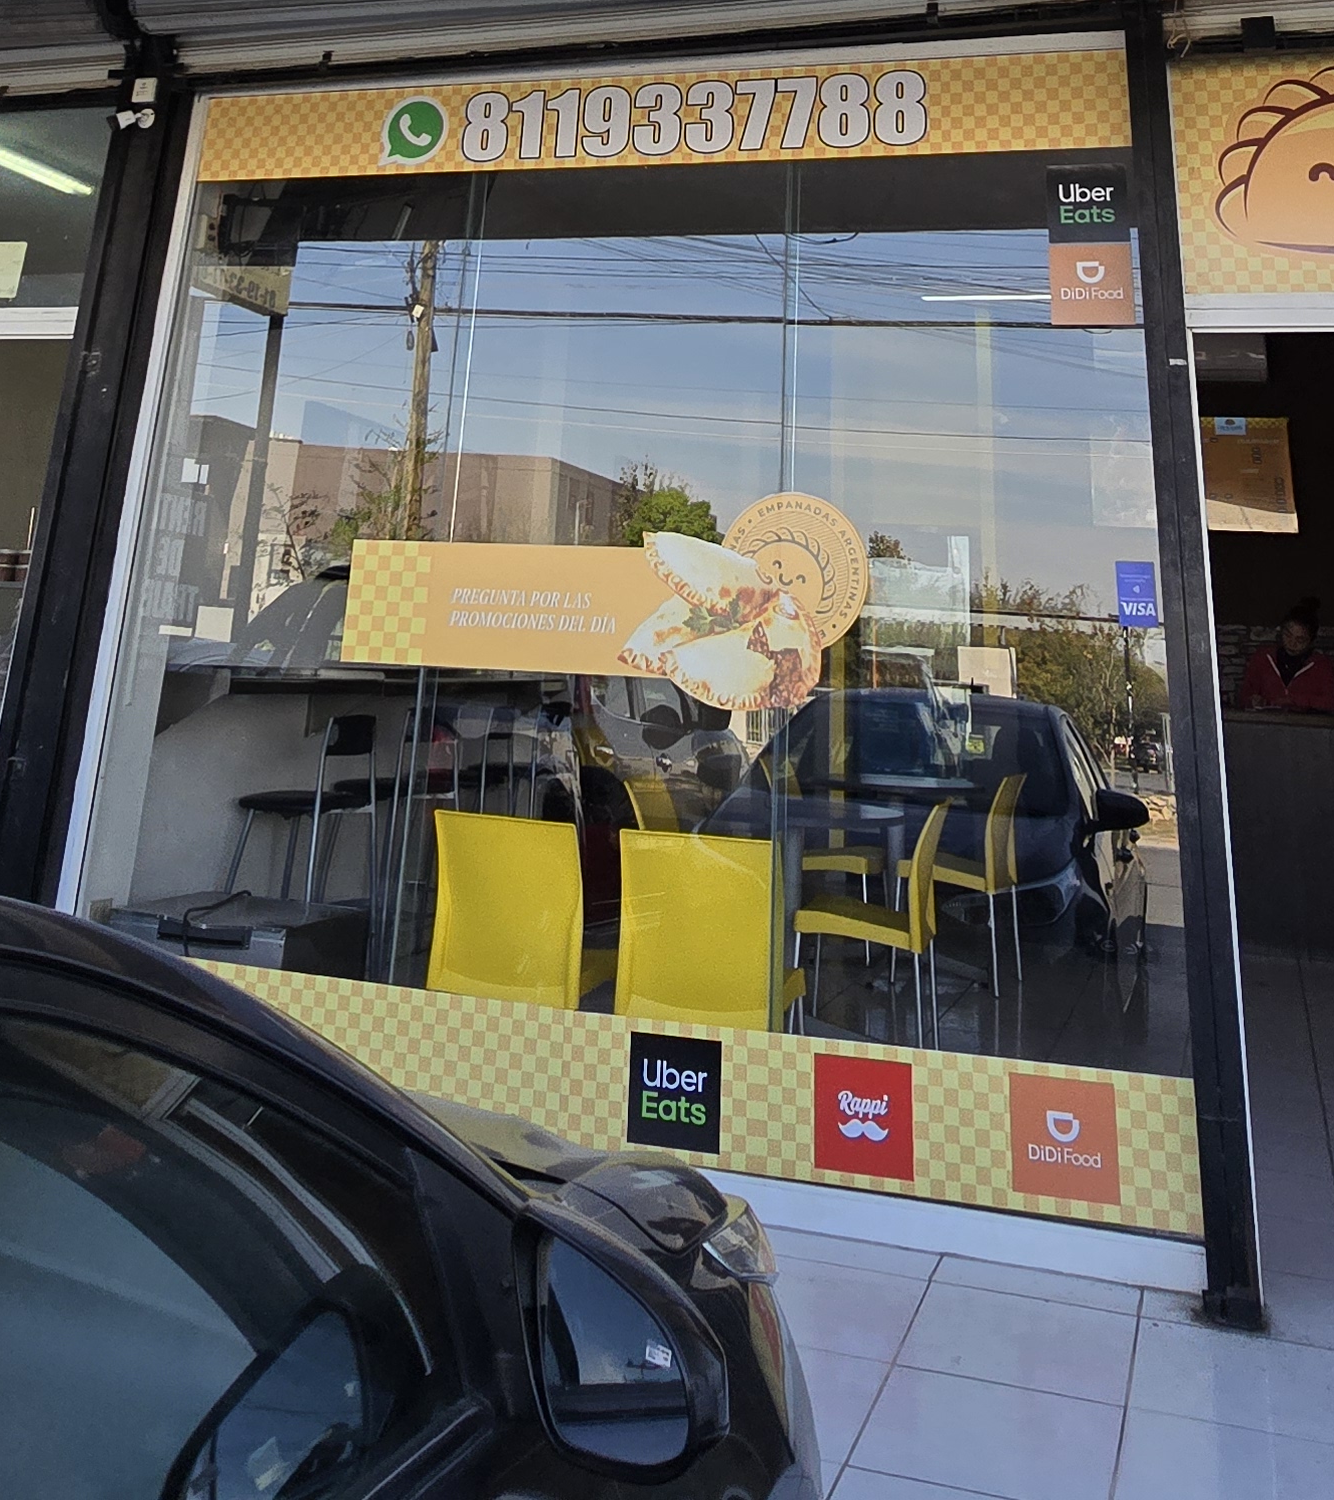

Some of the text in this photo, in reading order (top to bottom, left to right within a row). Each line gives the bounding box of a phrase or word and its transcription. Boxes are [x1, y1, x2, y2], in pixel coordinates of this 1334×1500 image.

[462, 68, 927, 163] 8119337788
[1058, 183, 1115, 203] Uber
[1059, 205, 1116, 224] Eats
[757, 500, 861, 619] EMPANADAS ARGENTINAS
[451, 587, 593, 609] PREGUNTA POR LAS
[1120, 601, 1157, 617] VISA
[449, 610, 616, 634] PROMOCIONES DEL DÍA
[642, 1057, 708, 1093] Uber
[641, 1090, 708, 1127] Eats
[837, 1089, 889, 1119] Rappi
